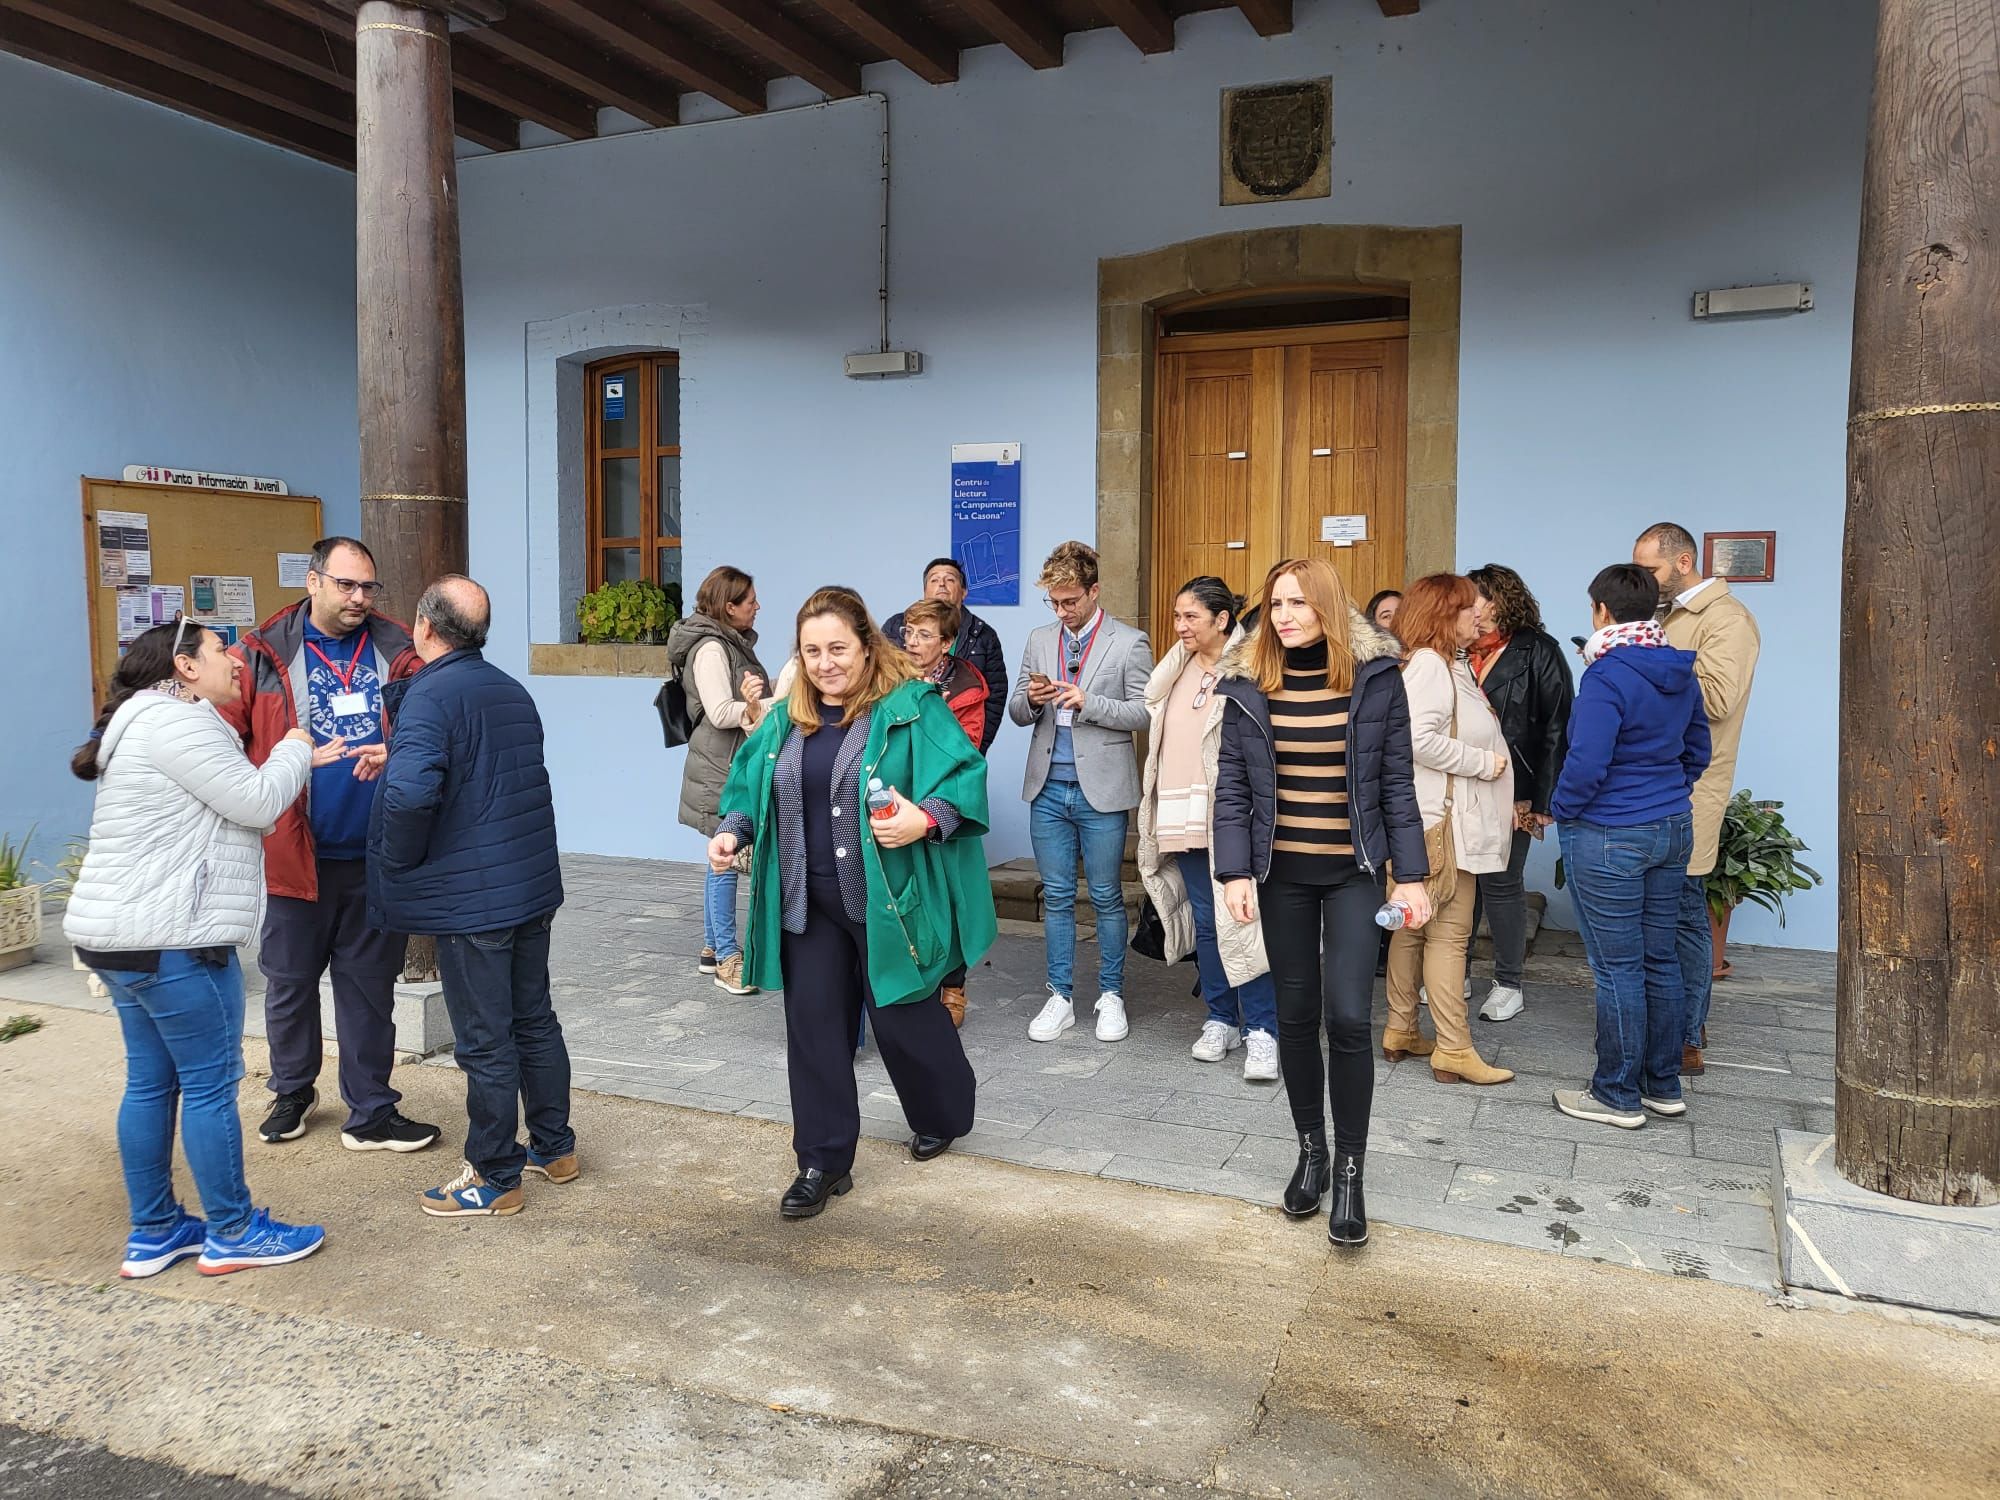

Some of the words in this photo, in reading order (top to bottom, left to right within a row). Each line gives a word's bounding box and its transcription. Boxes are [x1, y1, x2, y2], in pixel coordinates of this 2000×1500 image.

[164, 470, 193, 485] Punto
[954, 478, 982, 486] Centru
[961, 501, 1016, 510] Campumanes
[309, 694, 375, 737] SUPPLIES
